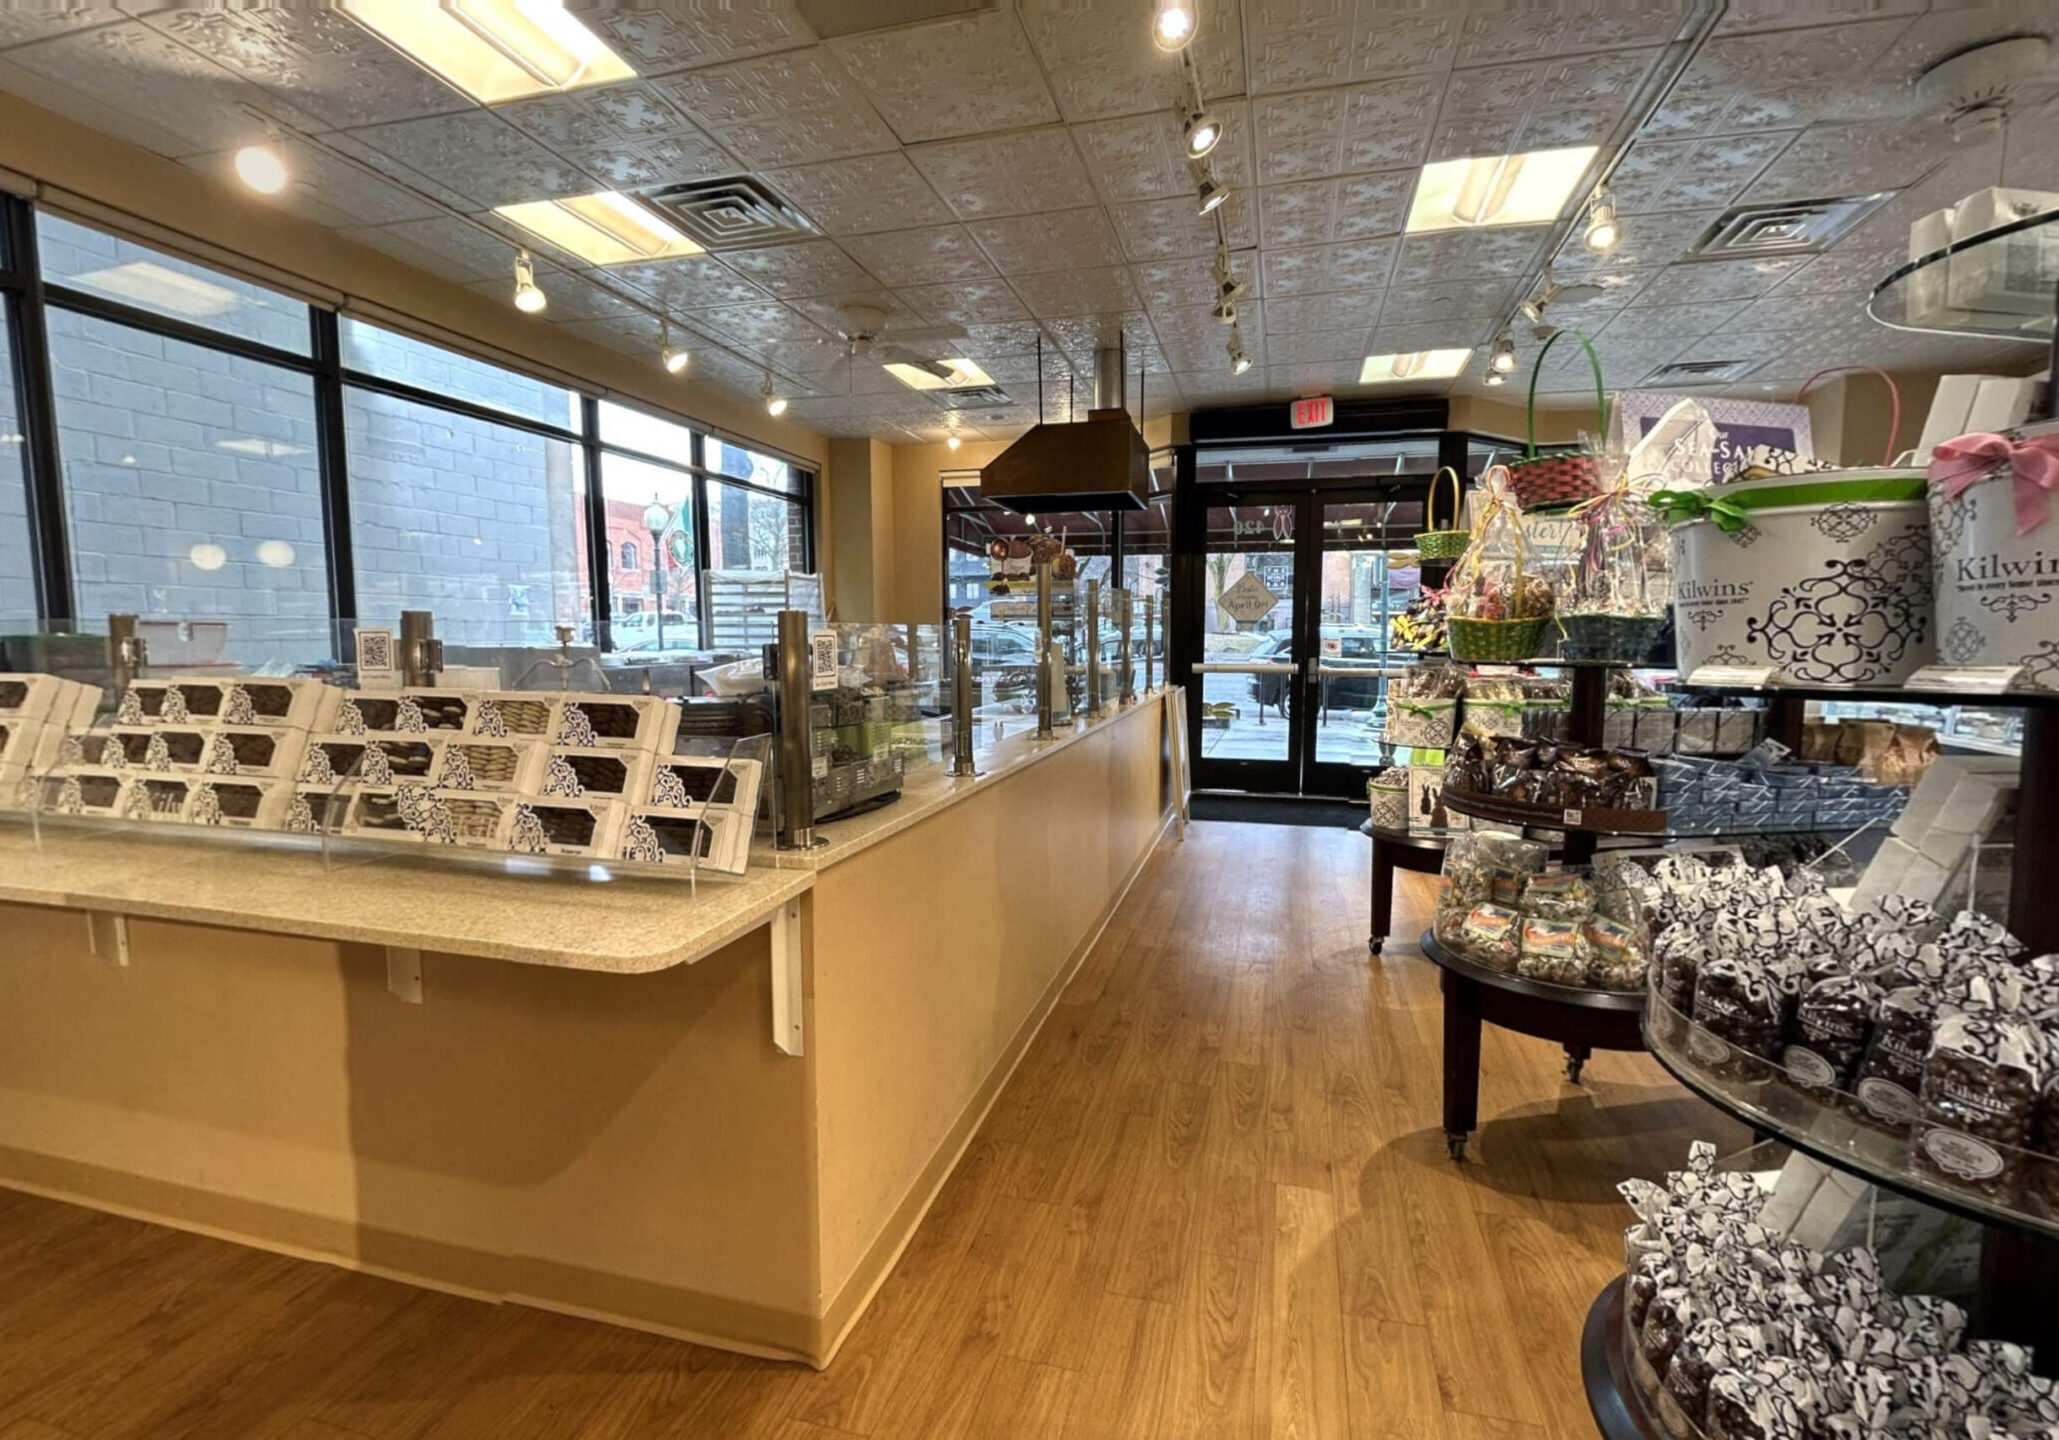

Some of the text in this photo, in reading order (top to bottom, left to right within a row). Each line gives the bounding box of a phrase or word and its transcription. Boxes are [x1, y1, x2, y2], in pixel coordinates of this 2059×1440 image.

[1297, 398, 1328, 425] EXIT
[1675, 438, 1754, 460] SEA-SAL
[1678, 579, 1749, 599] Kilwins
[1228, 600, 1251, 611] April
[1943, 1080, 2011, 1111] Kilwins
